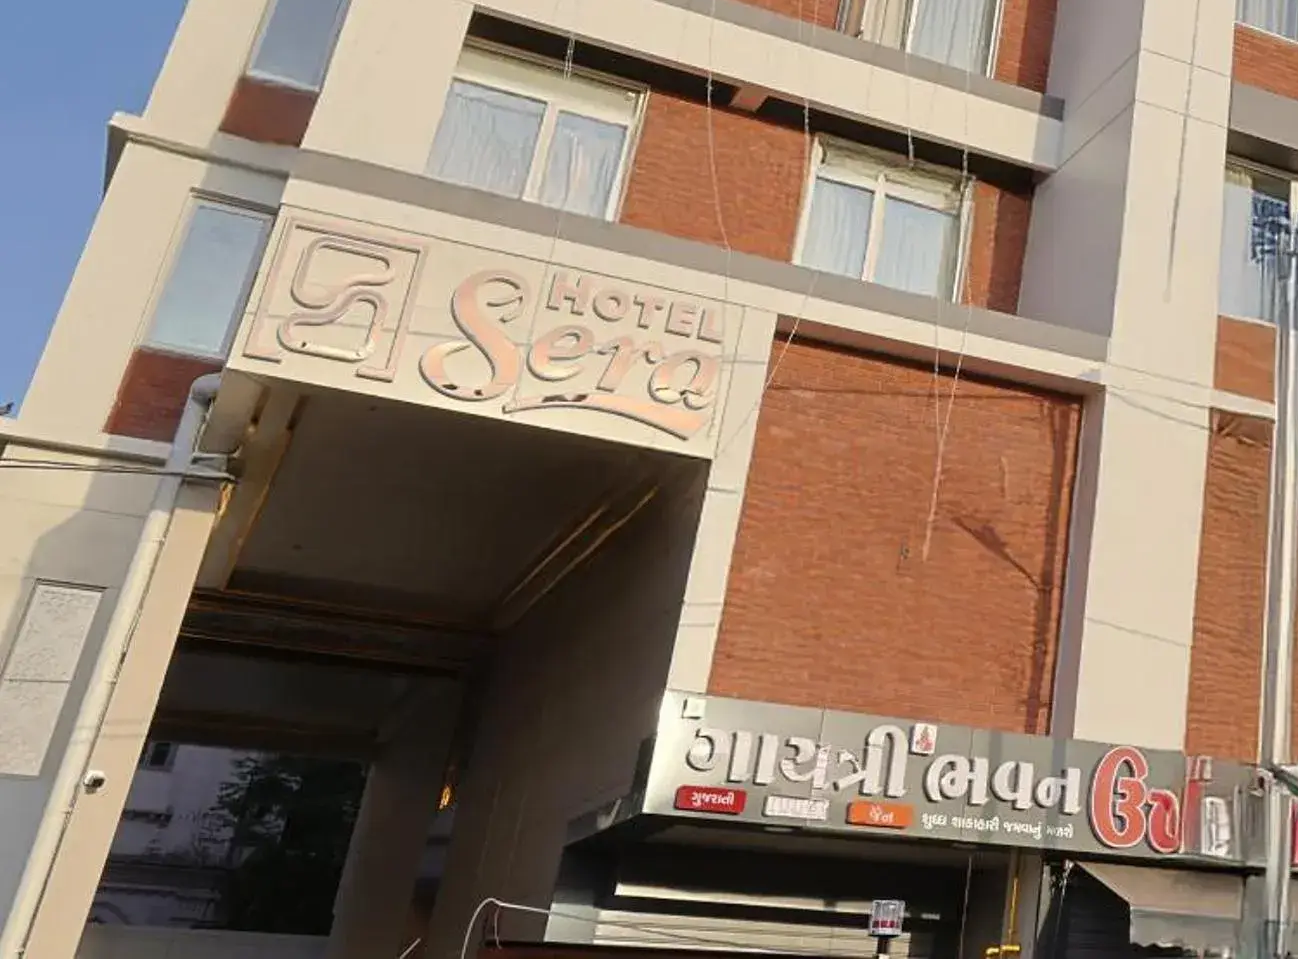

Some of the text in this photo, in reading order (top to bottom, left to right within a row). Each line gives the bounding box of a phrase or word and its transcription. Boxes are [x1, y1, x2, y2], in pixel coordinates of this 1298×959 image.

[418, 268, 723, 411] Sera
[546, 271, 725, 345] HOTEL
[923, 753, 1083, 816] ભવન
